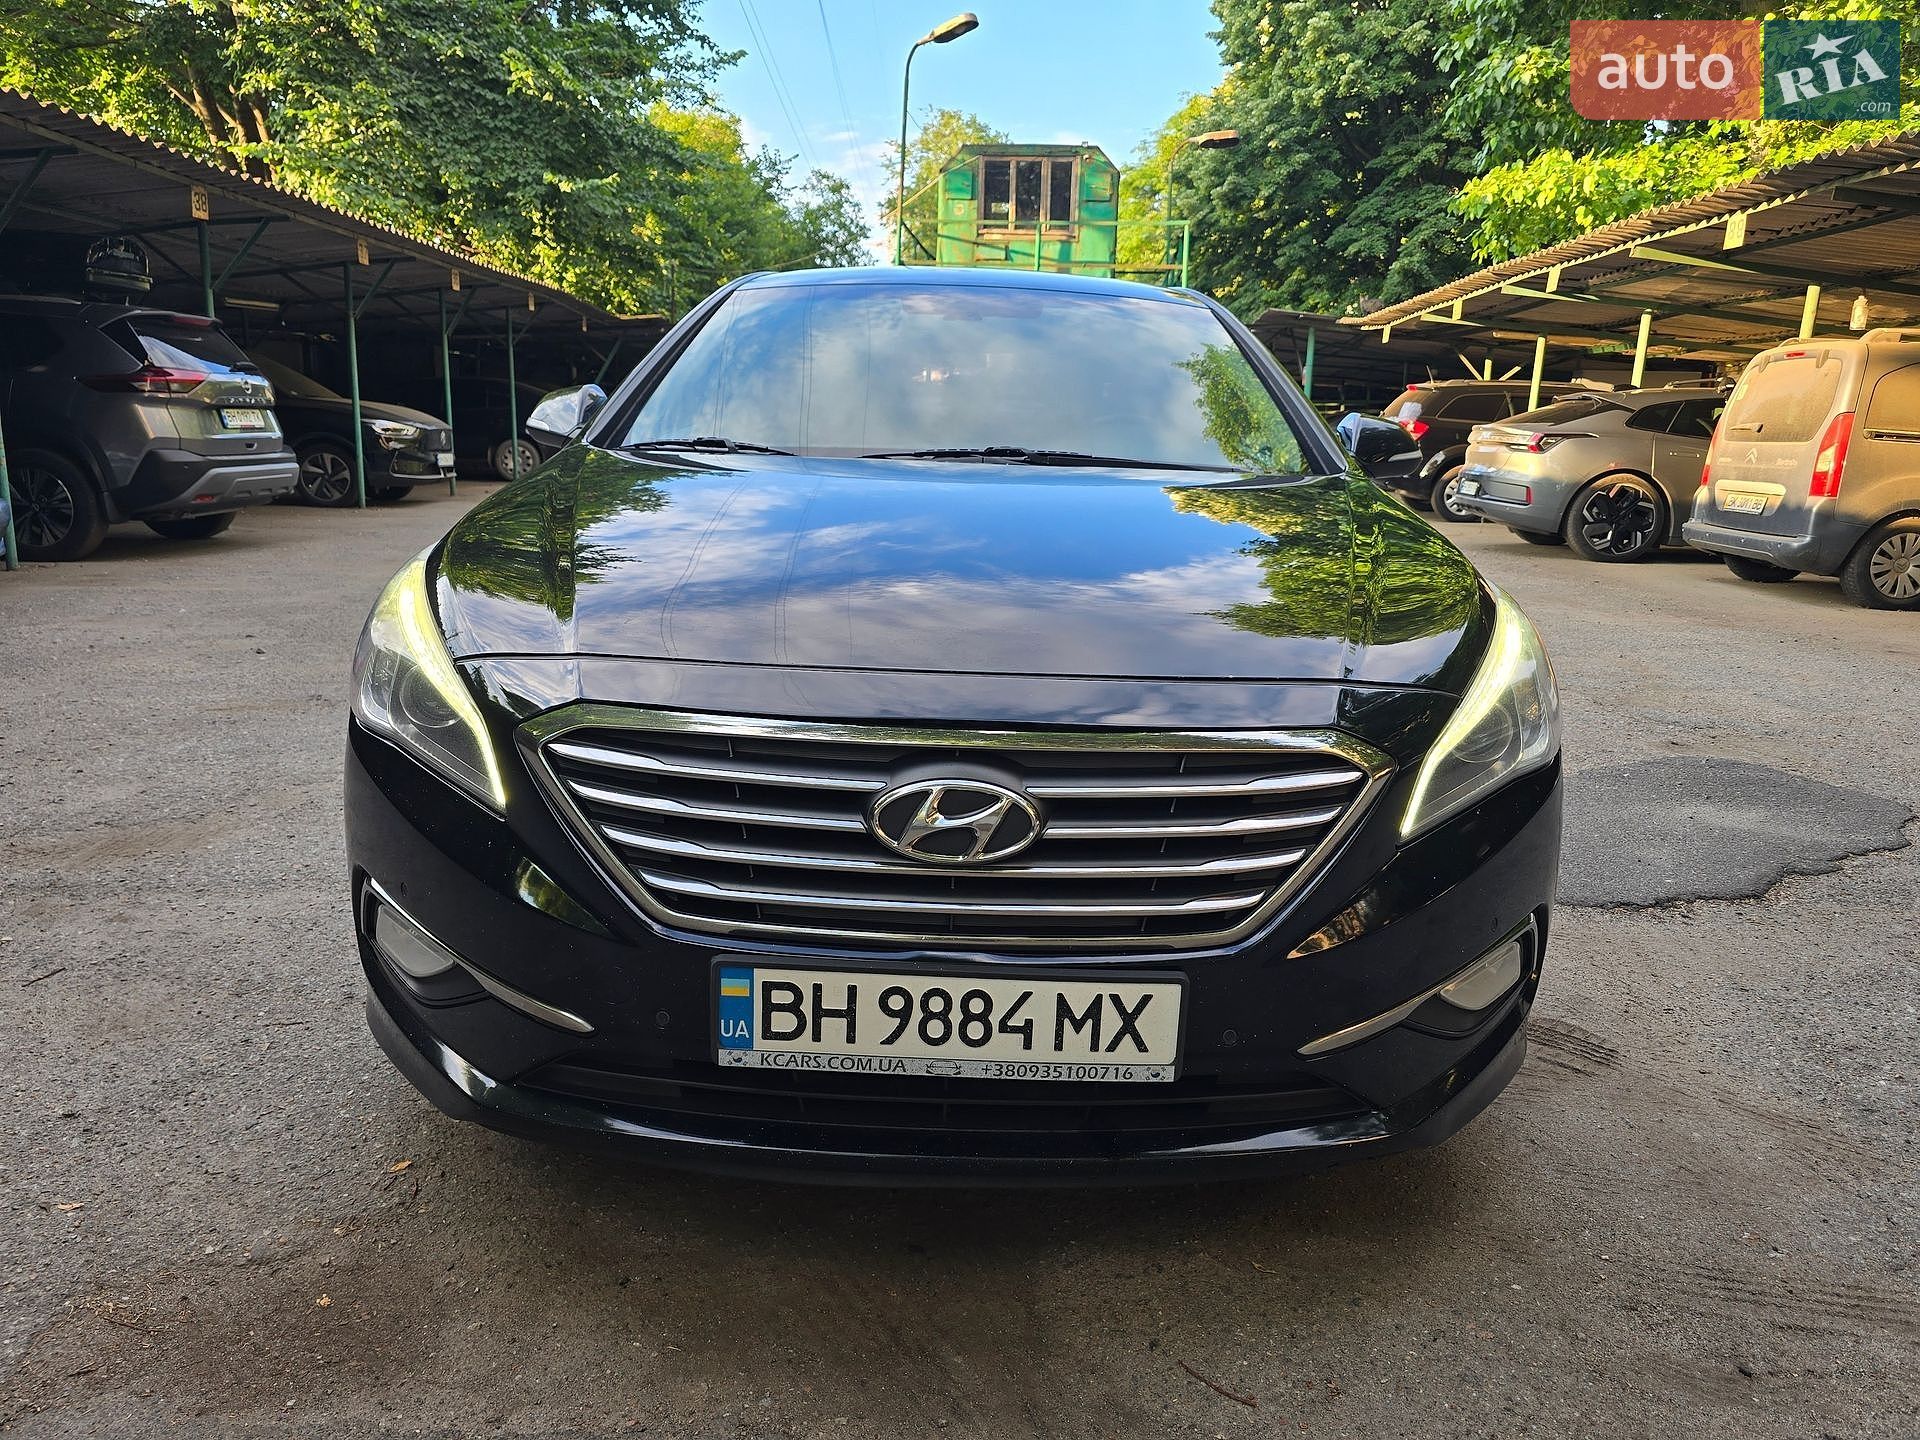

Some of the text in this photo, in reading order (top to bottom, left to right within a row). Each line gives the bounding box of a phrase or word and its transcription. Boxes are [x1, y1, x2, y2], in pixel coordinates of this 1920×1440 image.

[193, 191, 207, 213] 38
[720, 1018, 750, 1038] UA
[761, 980, 1154, 1053] BH 9884 MX
[759, 1052, 1134, 1080] KCARS.COM.UA +380935100716
